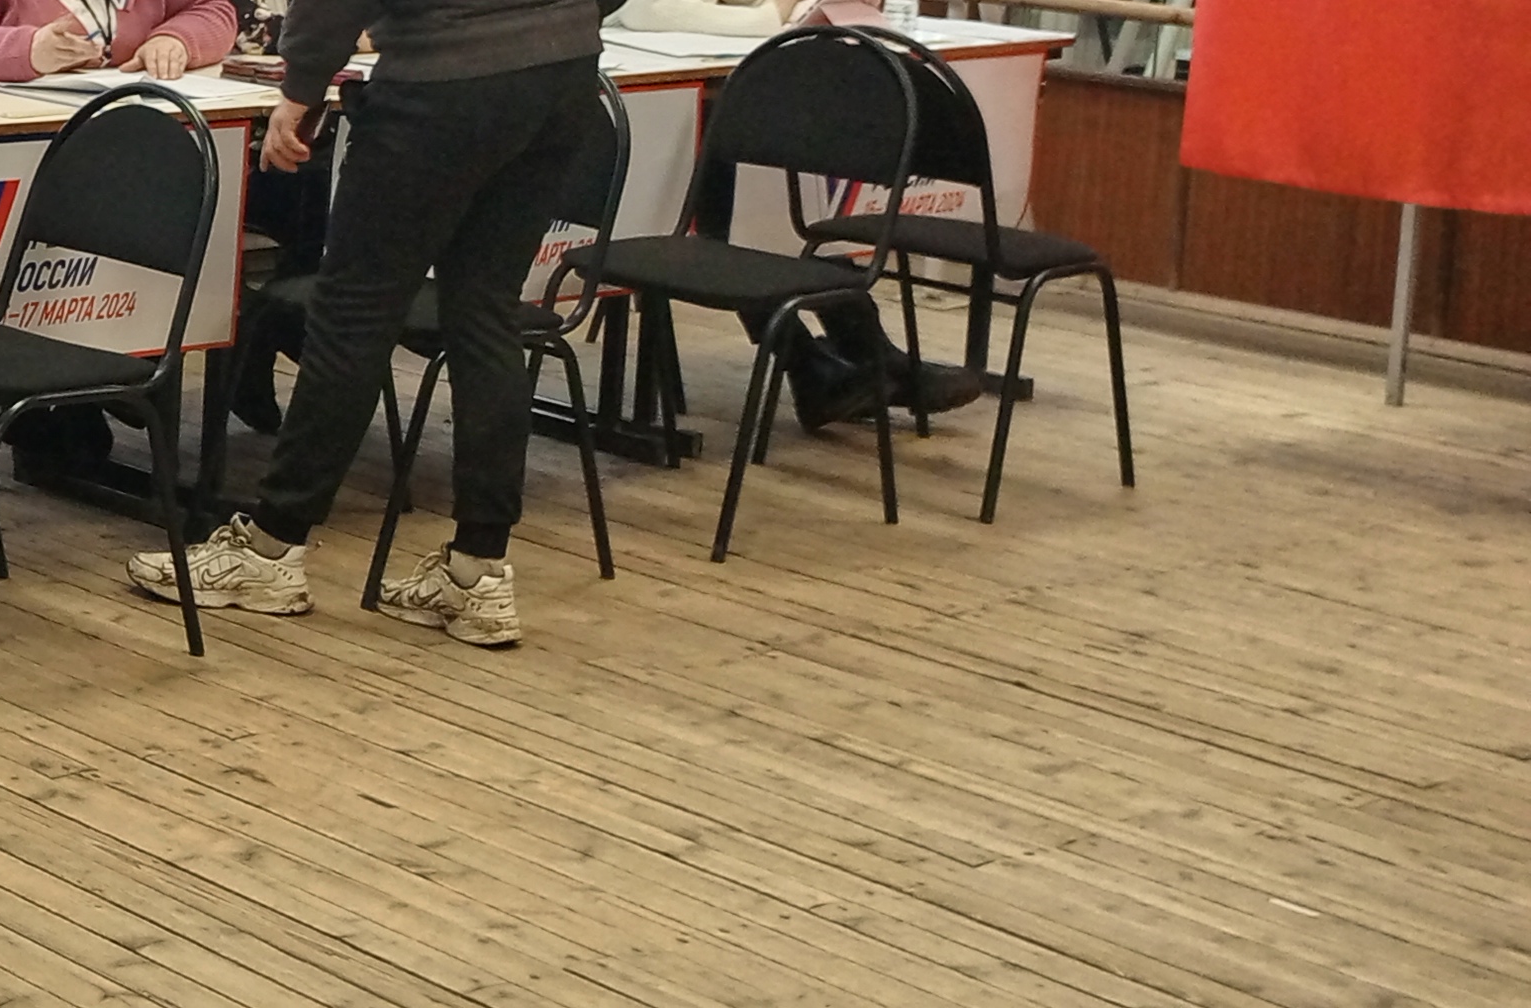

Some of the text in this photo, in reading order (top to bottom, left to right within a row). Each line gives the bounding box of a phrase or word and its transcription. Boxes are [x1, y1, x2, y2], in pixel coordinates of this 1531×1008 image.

[17, 257, 99, 292] ОССИИ
[38, 295, 96, 327] МАРТА
[95, 291, 137, 320] 2024
